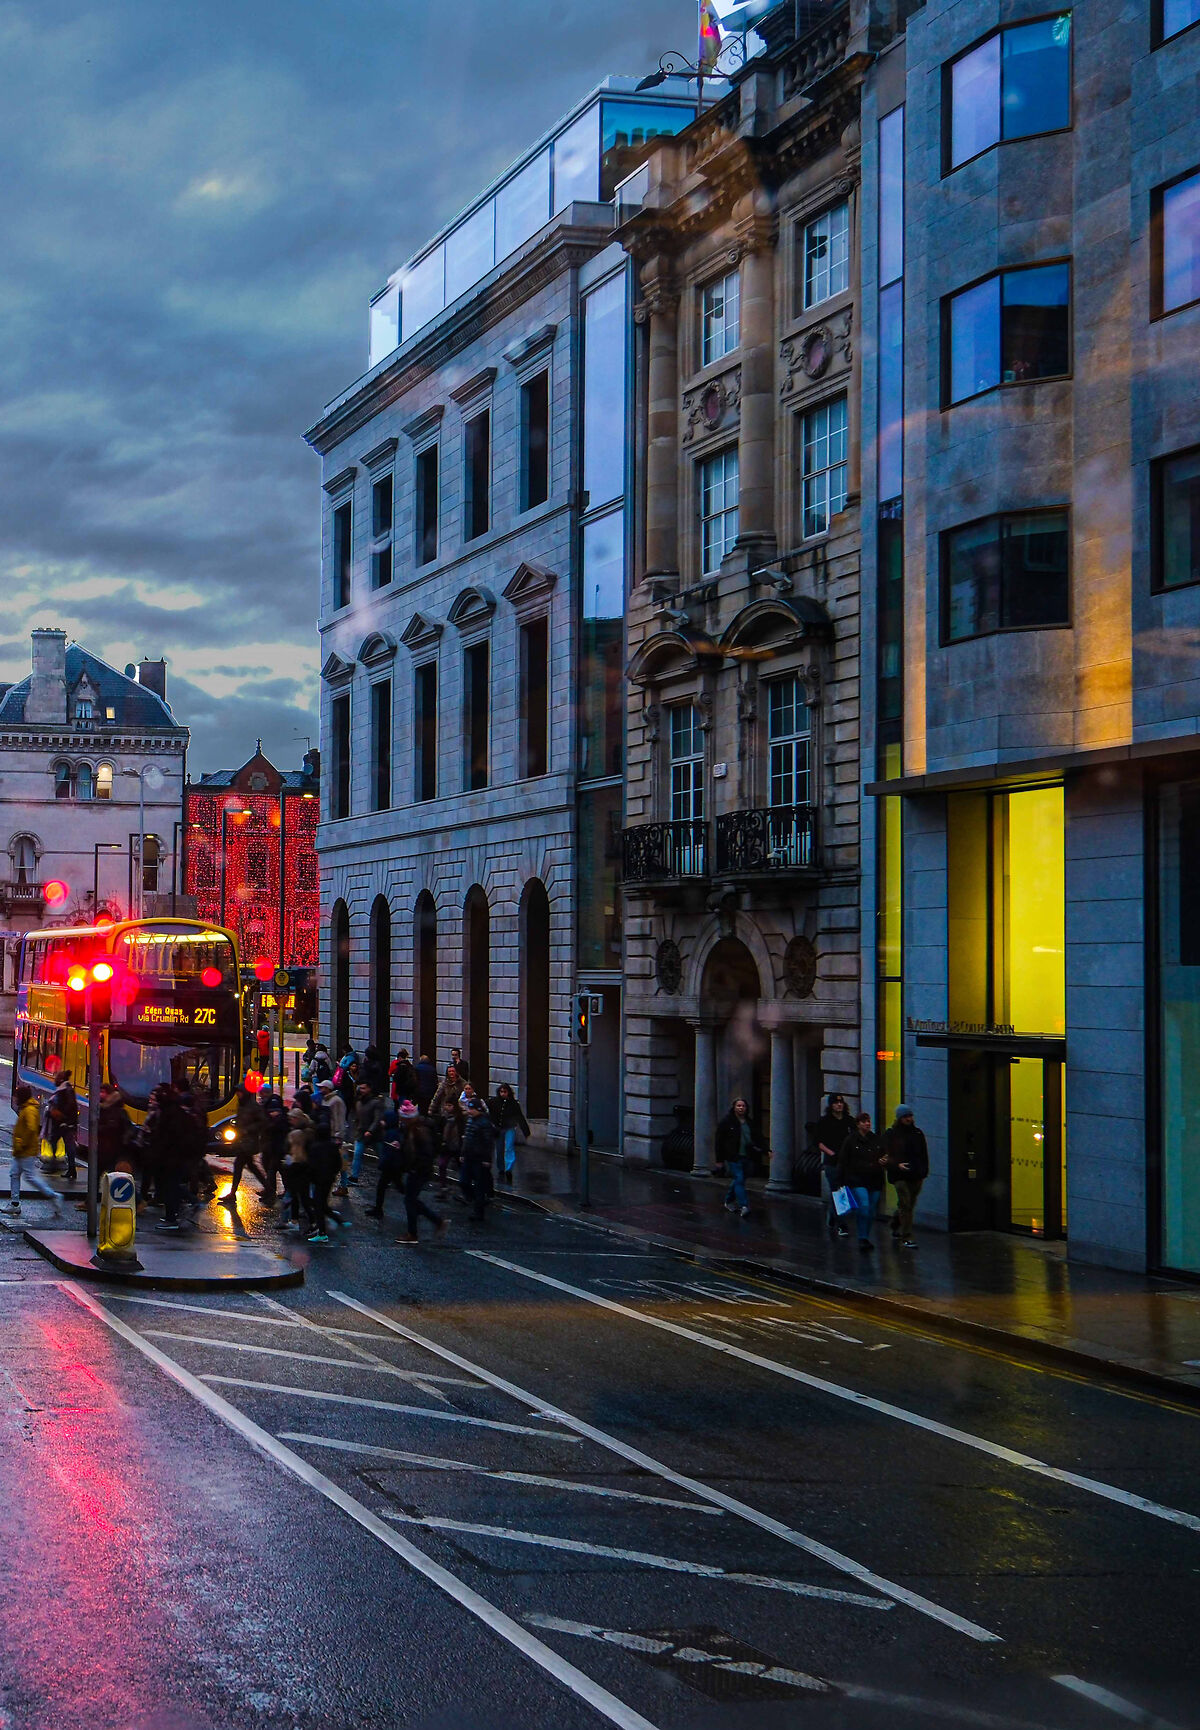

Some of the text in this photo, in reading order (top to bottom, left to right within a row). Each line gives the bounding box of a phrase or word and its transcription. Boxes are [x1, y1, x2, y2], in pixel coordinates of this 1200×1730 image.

[144, 1006, 183, 1015] Eden Quay
[137, 1014, 189, 1023] via Crumlin Rd
[194, 1008, 216, 1024] 27C
